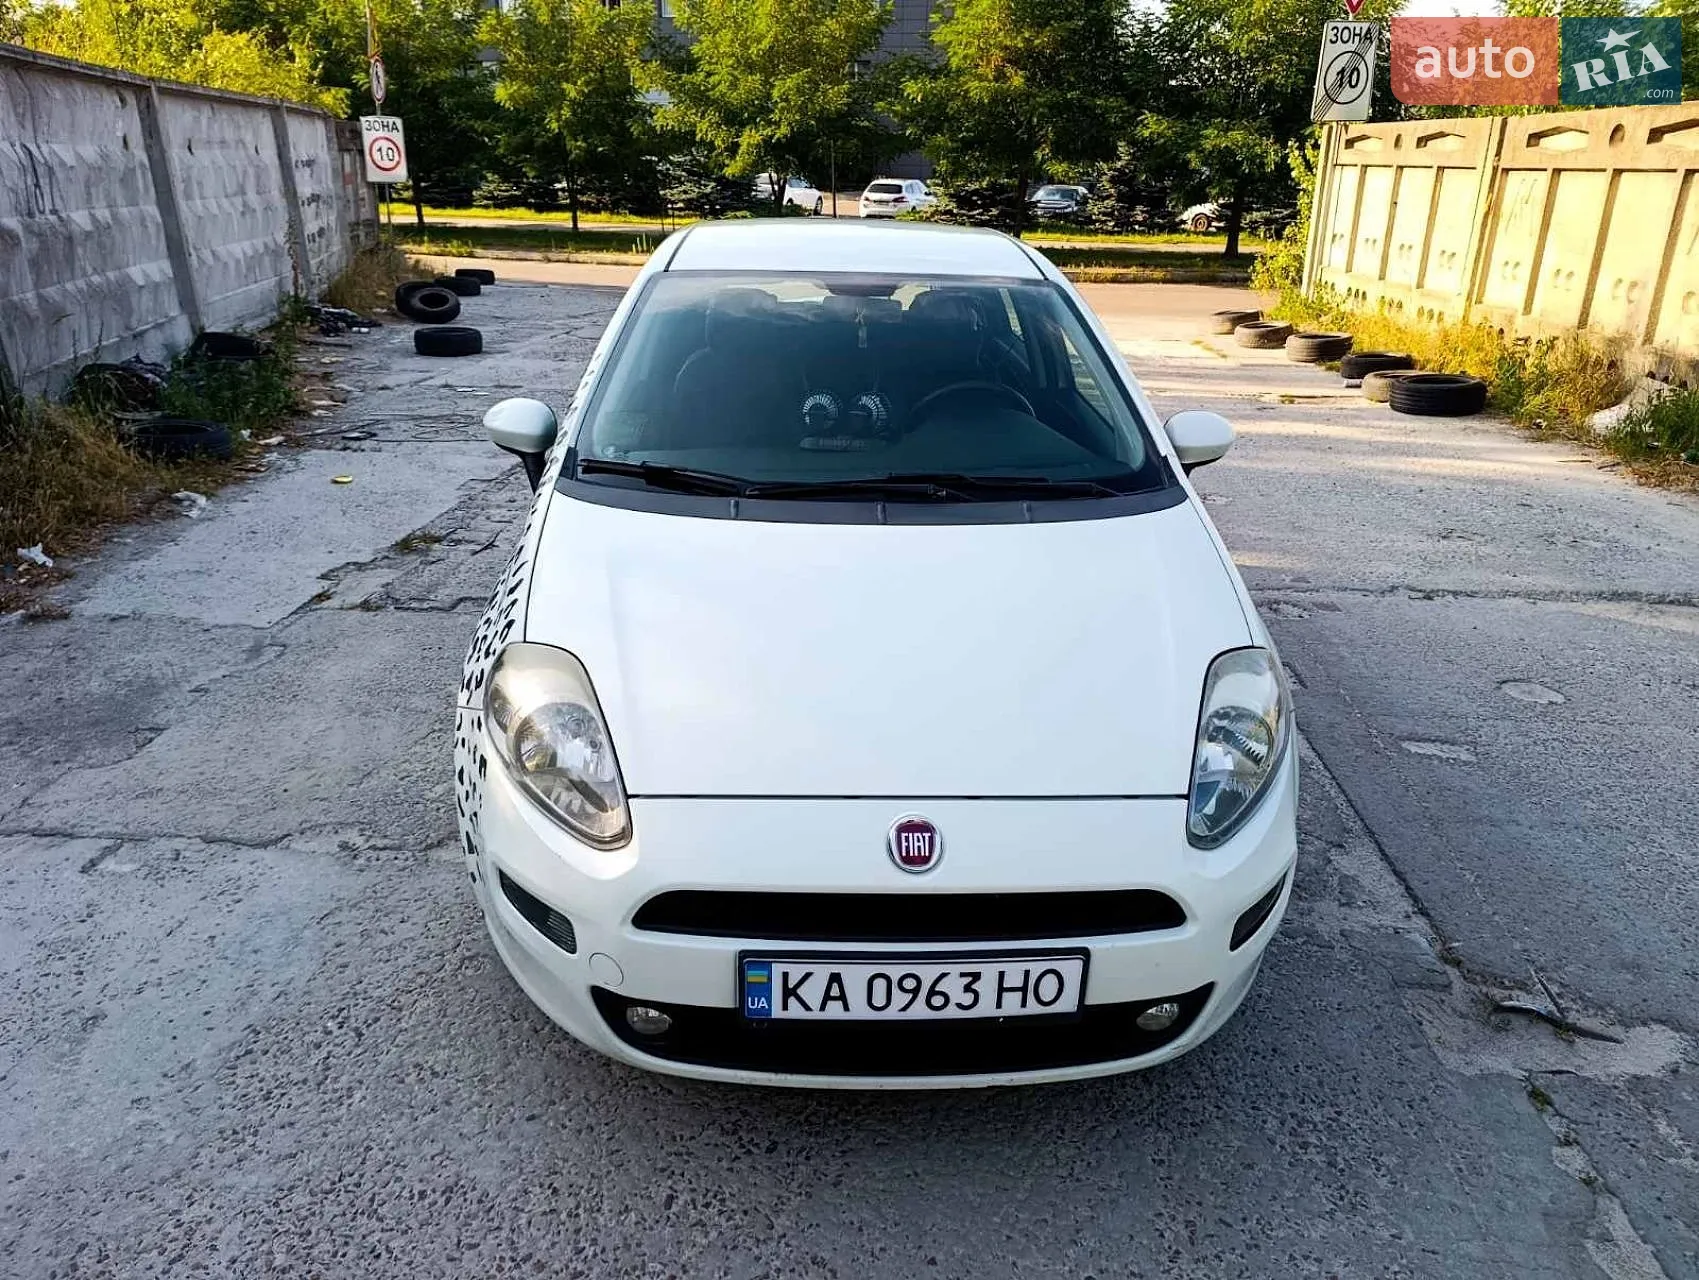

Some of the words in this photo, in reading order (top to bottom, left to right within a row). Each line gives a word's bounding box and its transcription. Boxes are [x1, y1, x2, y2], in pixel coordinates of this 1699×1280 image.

[1330, 26, 1374, 44] ЗОНА
[1336, 66, 1360, 89] 10
[364, 119, 400, 133] ЗОНА
[377, 146, 395, 162] 10
[901, 832, 931, 857] FIAT
[781, 971, 851, 1012] KA
[866, 971, 982, 1012] 0963
[995, 968, 1065, 1010] HO
[748, 997, 768, 1009] UA
